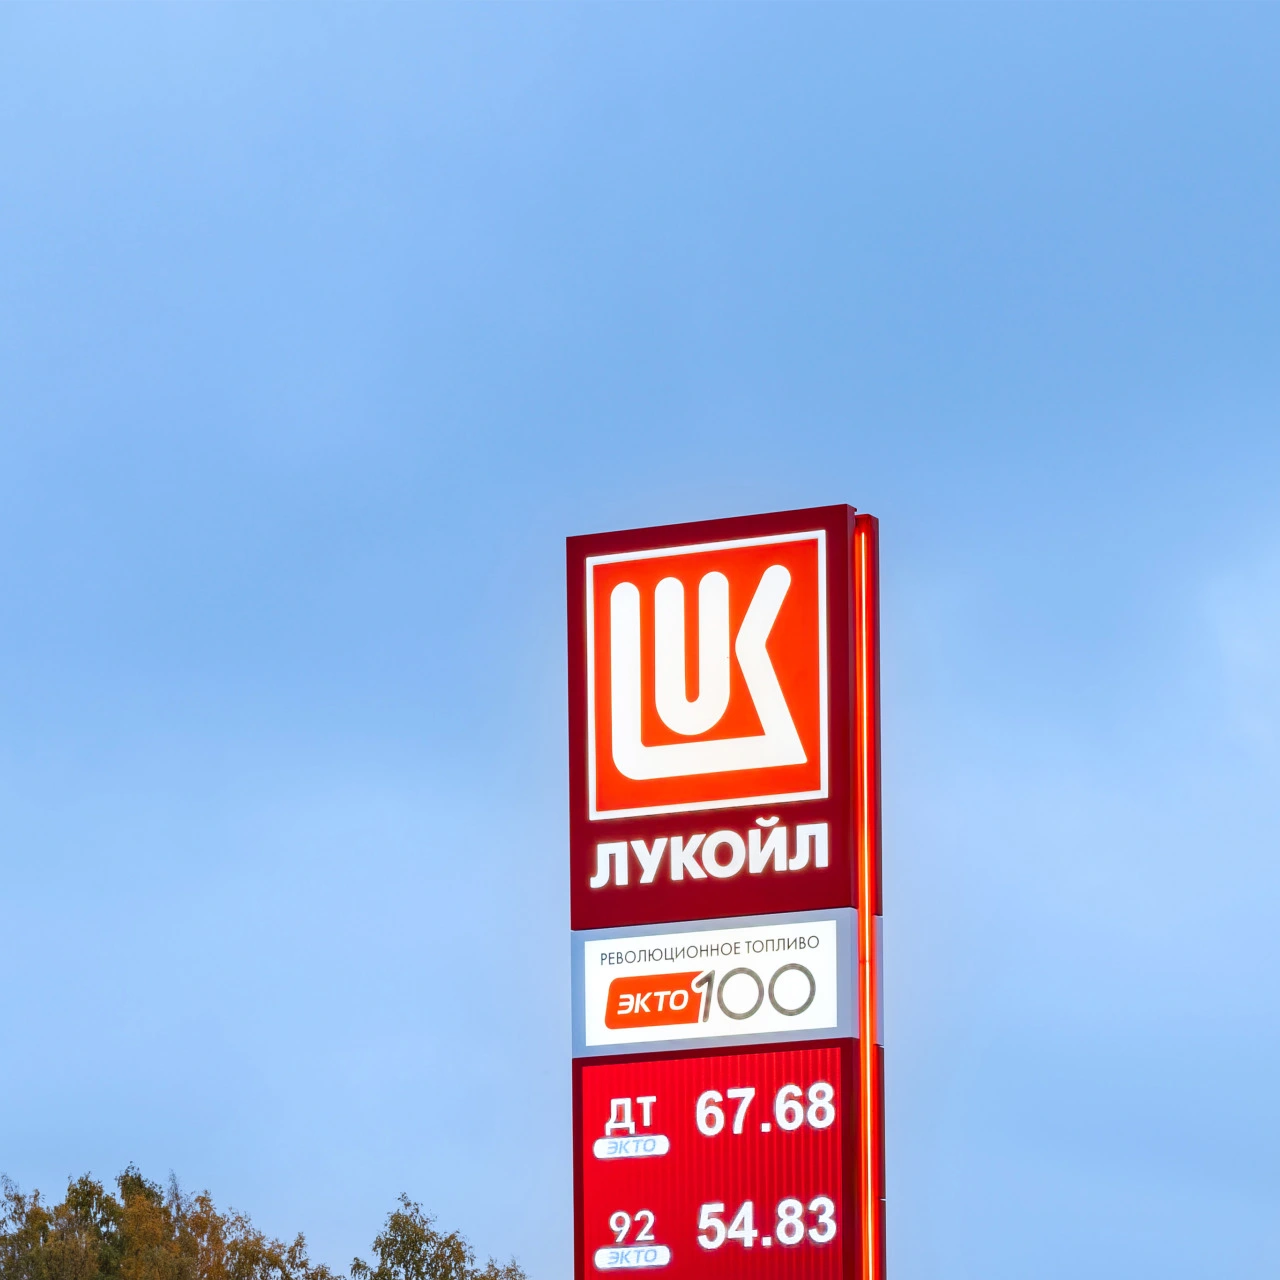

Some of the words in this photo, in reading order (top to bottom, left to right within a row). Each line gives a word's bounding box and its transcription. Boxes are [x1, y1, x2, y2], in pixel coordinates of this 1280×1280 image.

[590, 816, 829, 889] ЛУКОЙЛ
[600, 942, 741, 966] РЕВОЛЮЦИОННОЕ
[744, 935, 820, 954] ТОПЛИВО
[605, 1096, 657, 1136] ДТ
[696, 1081, 836, 1136] 67.68
[607, 1139, 656, 1155] ЭКТО
[610, 1209, 655, 1243] 92
[697, 1197, 837, 1250] 54.83
[607, 1249, 657, 1265] ЭКТО
